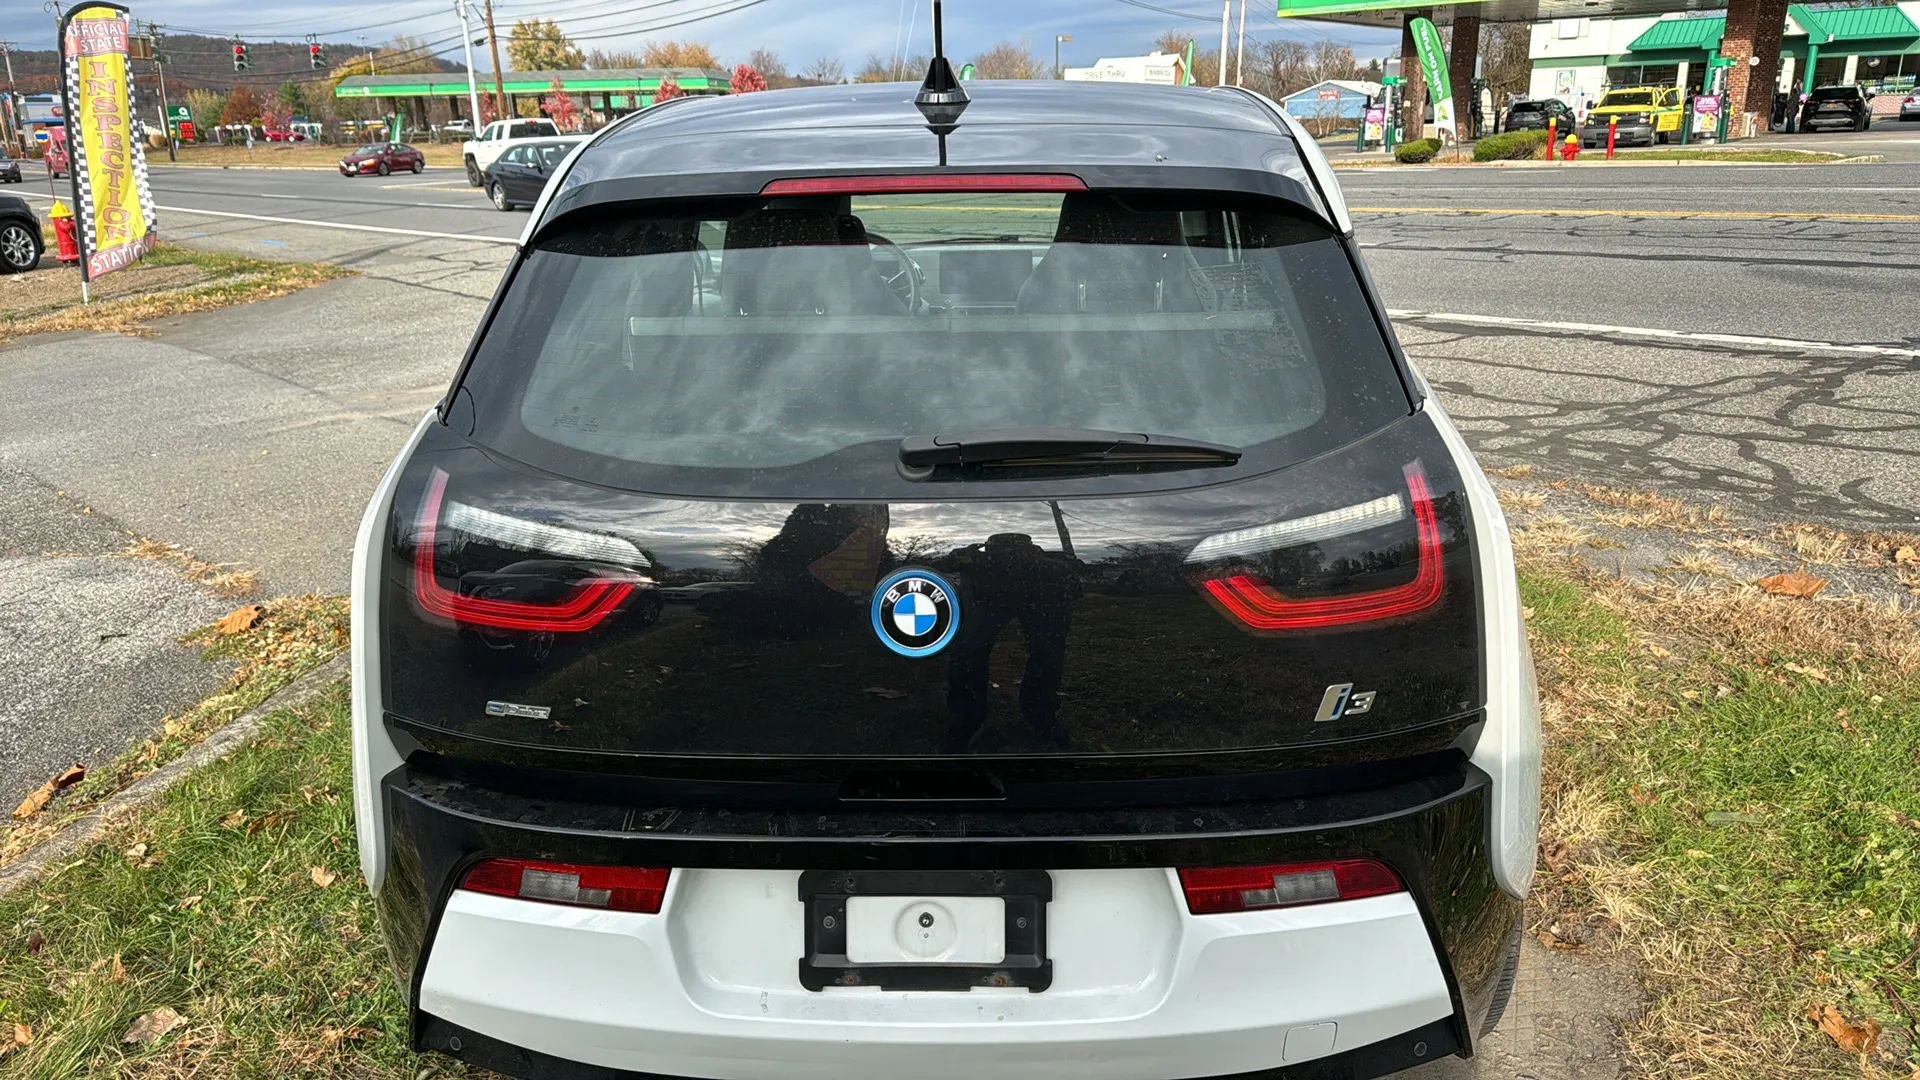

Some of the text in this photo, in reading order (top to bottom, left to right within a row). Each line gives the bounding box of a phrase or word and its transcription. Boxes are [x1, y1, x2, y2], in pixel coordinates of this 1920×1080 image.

[67, 21, 126, 39] OFFICIAL
[81, 35, 124, 50] STATE
[86, 61, 132, 242] INSPECTION
[90, 239, 151, 274] STATION
[886, 580, 945, 604] BMW
[1313, 682, 1377, 722] i3
